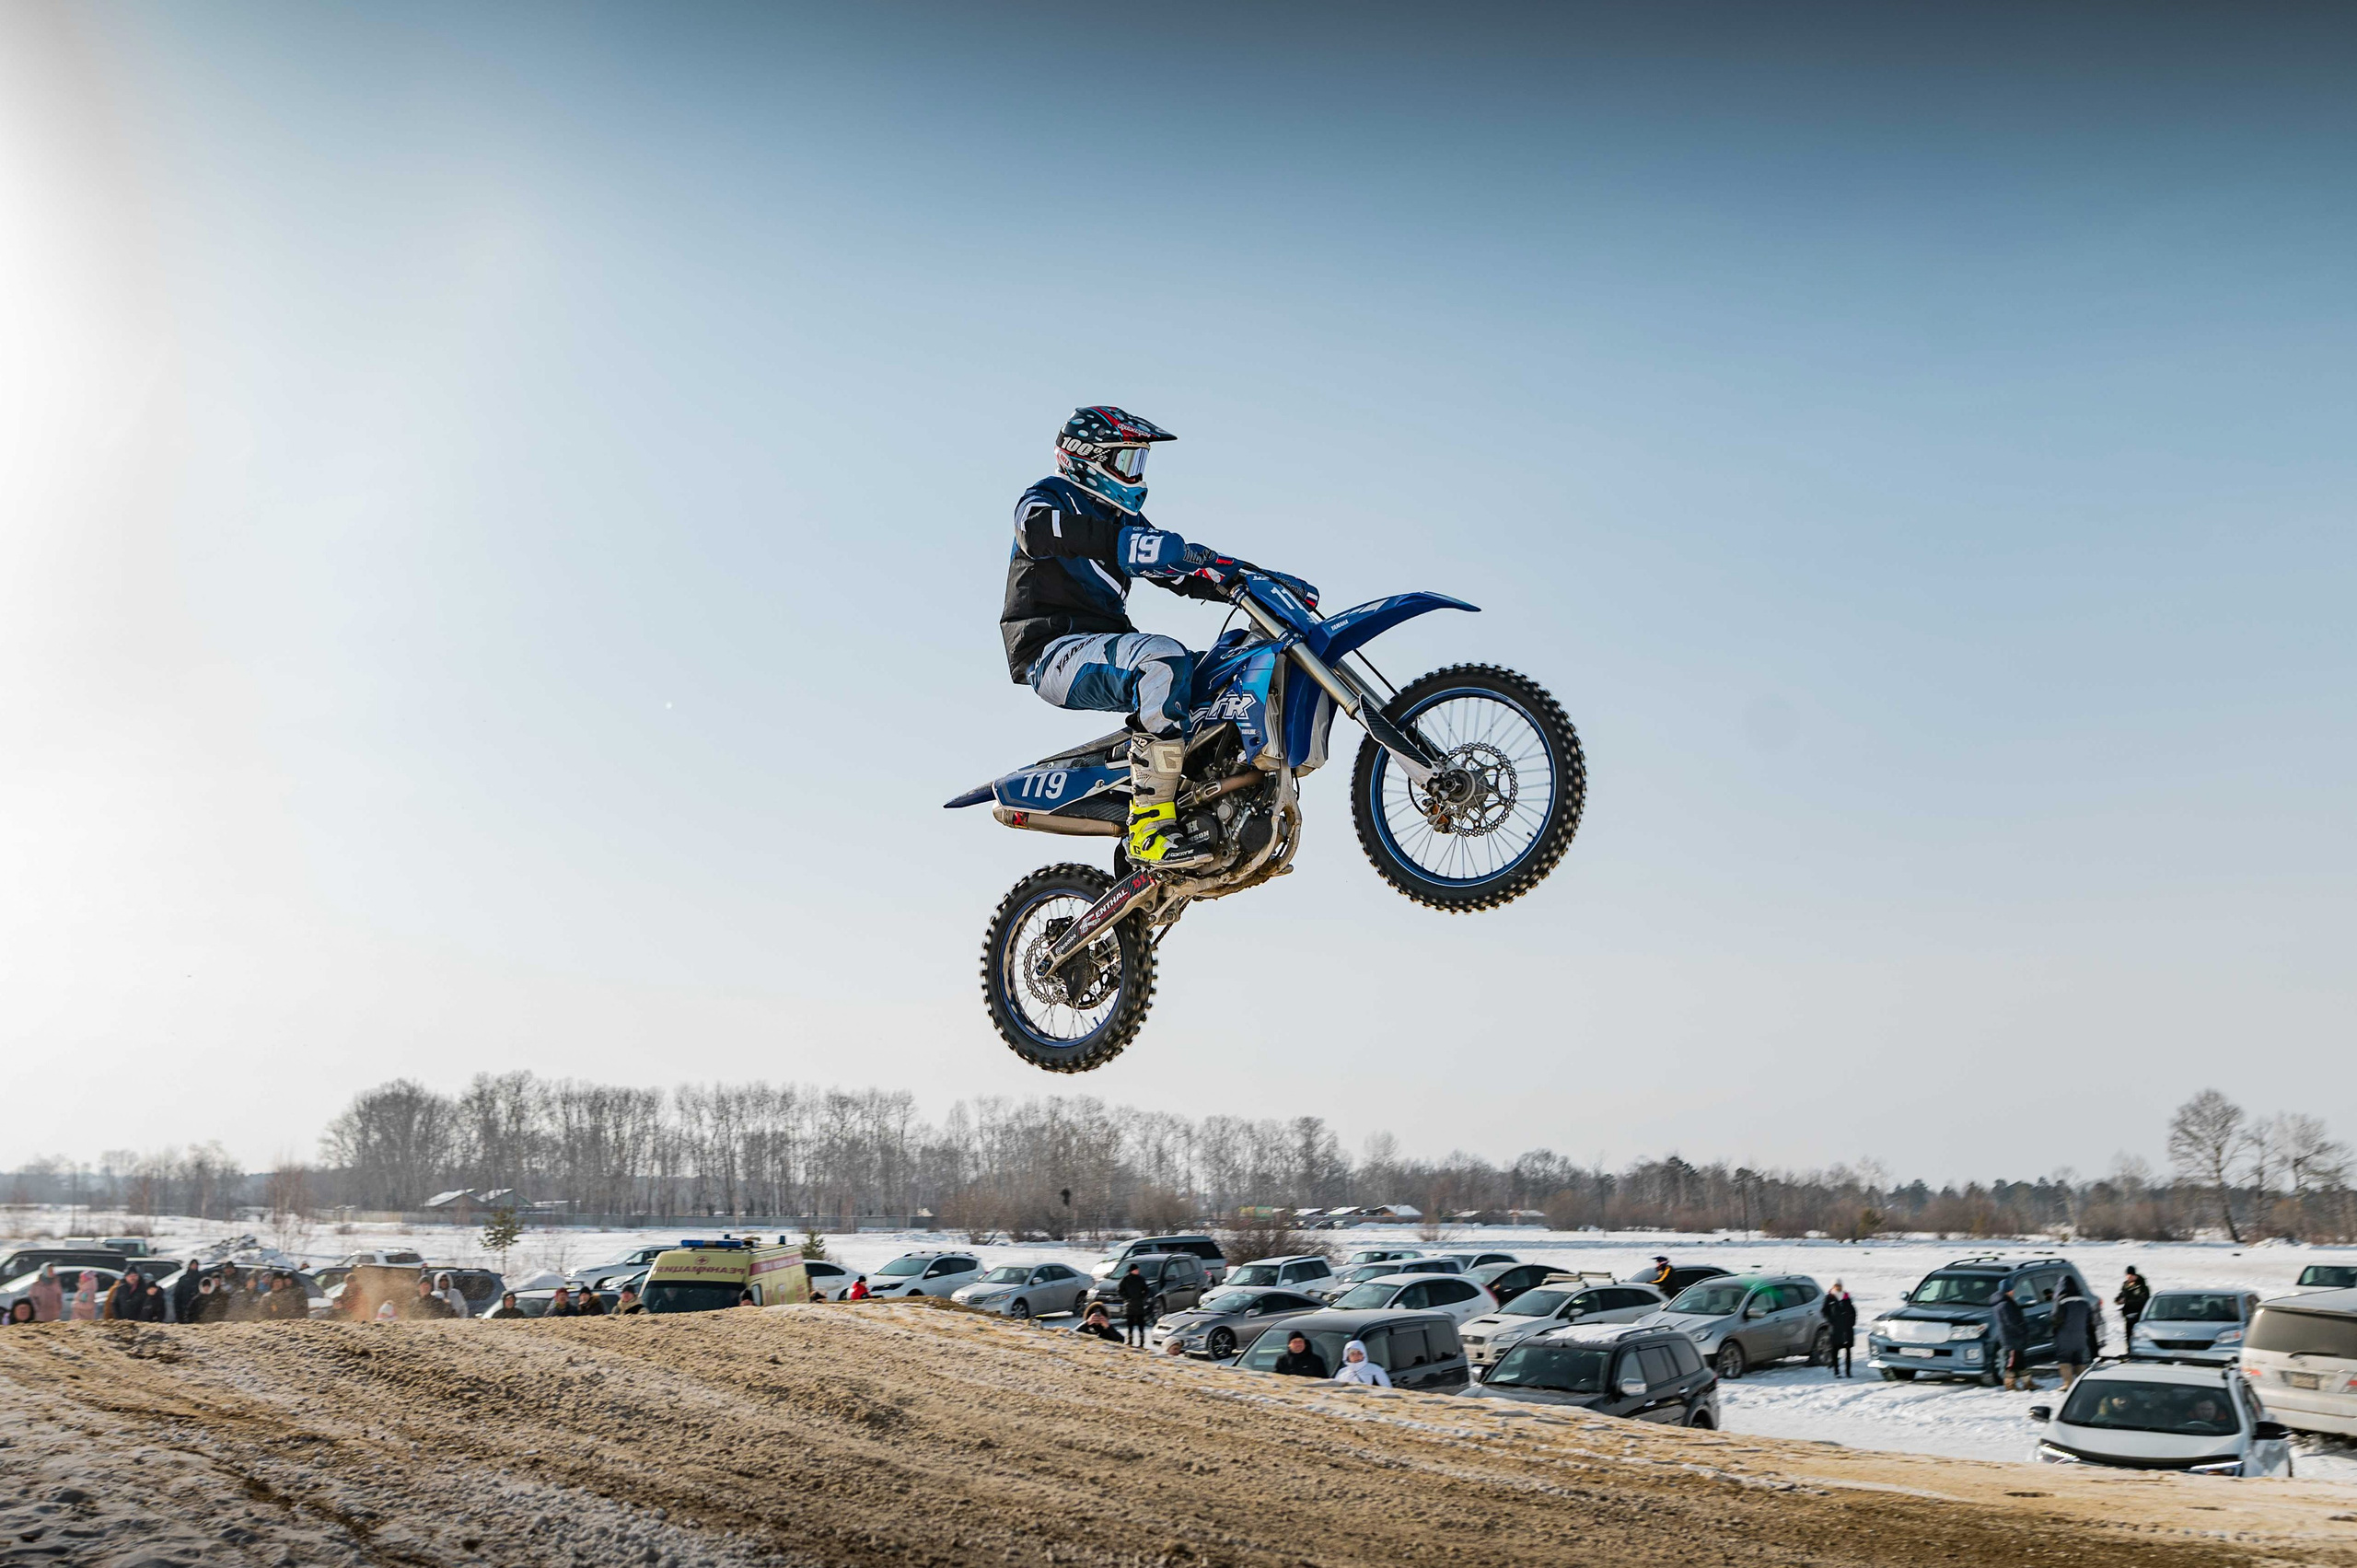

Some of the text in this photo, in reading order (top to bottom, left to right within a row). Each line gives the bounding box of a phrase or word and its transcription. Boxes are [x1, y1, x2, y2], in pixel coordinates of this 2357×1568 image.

[1061, 436, 1110, 462] 100%
[1128, 533, 1165, 563] 19
[1330, 619, 1349, 632] YAMAHA
[1021, 772, 1068, 799] 119
[1079, 889, 1130, 935] RENTHAL
